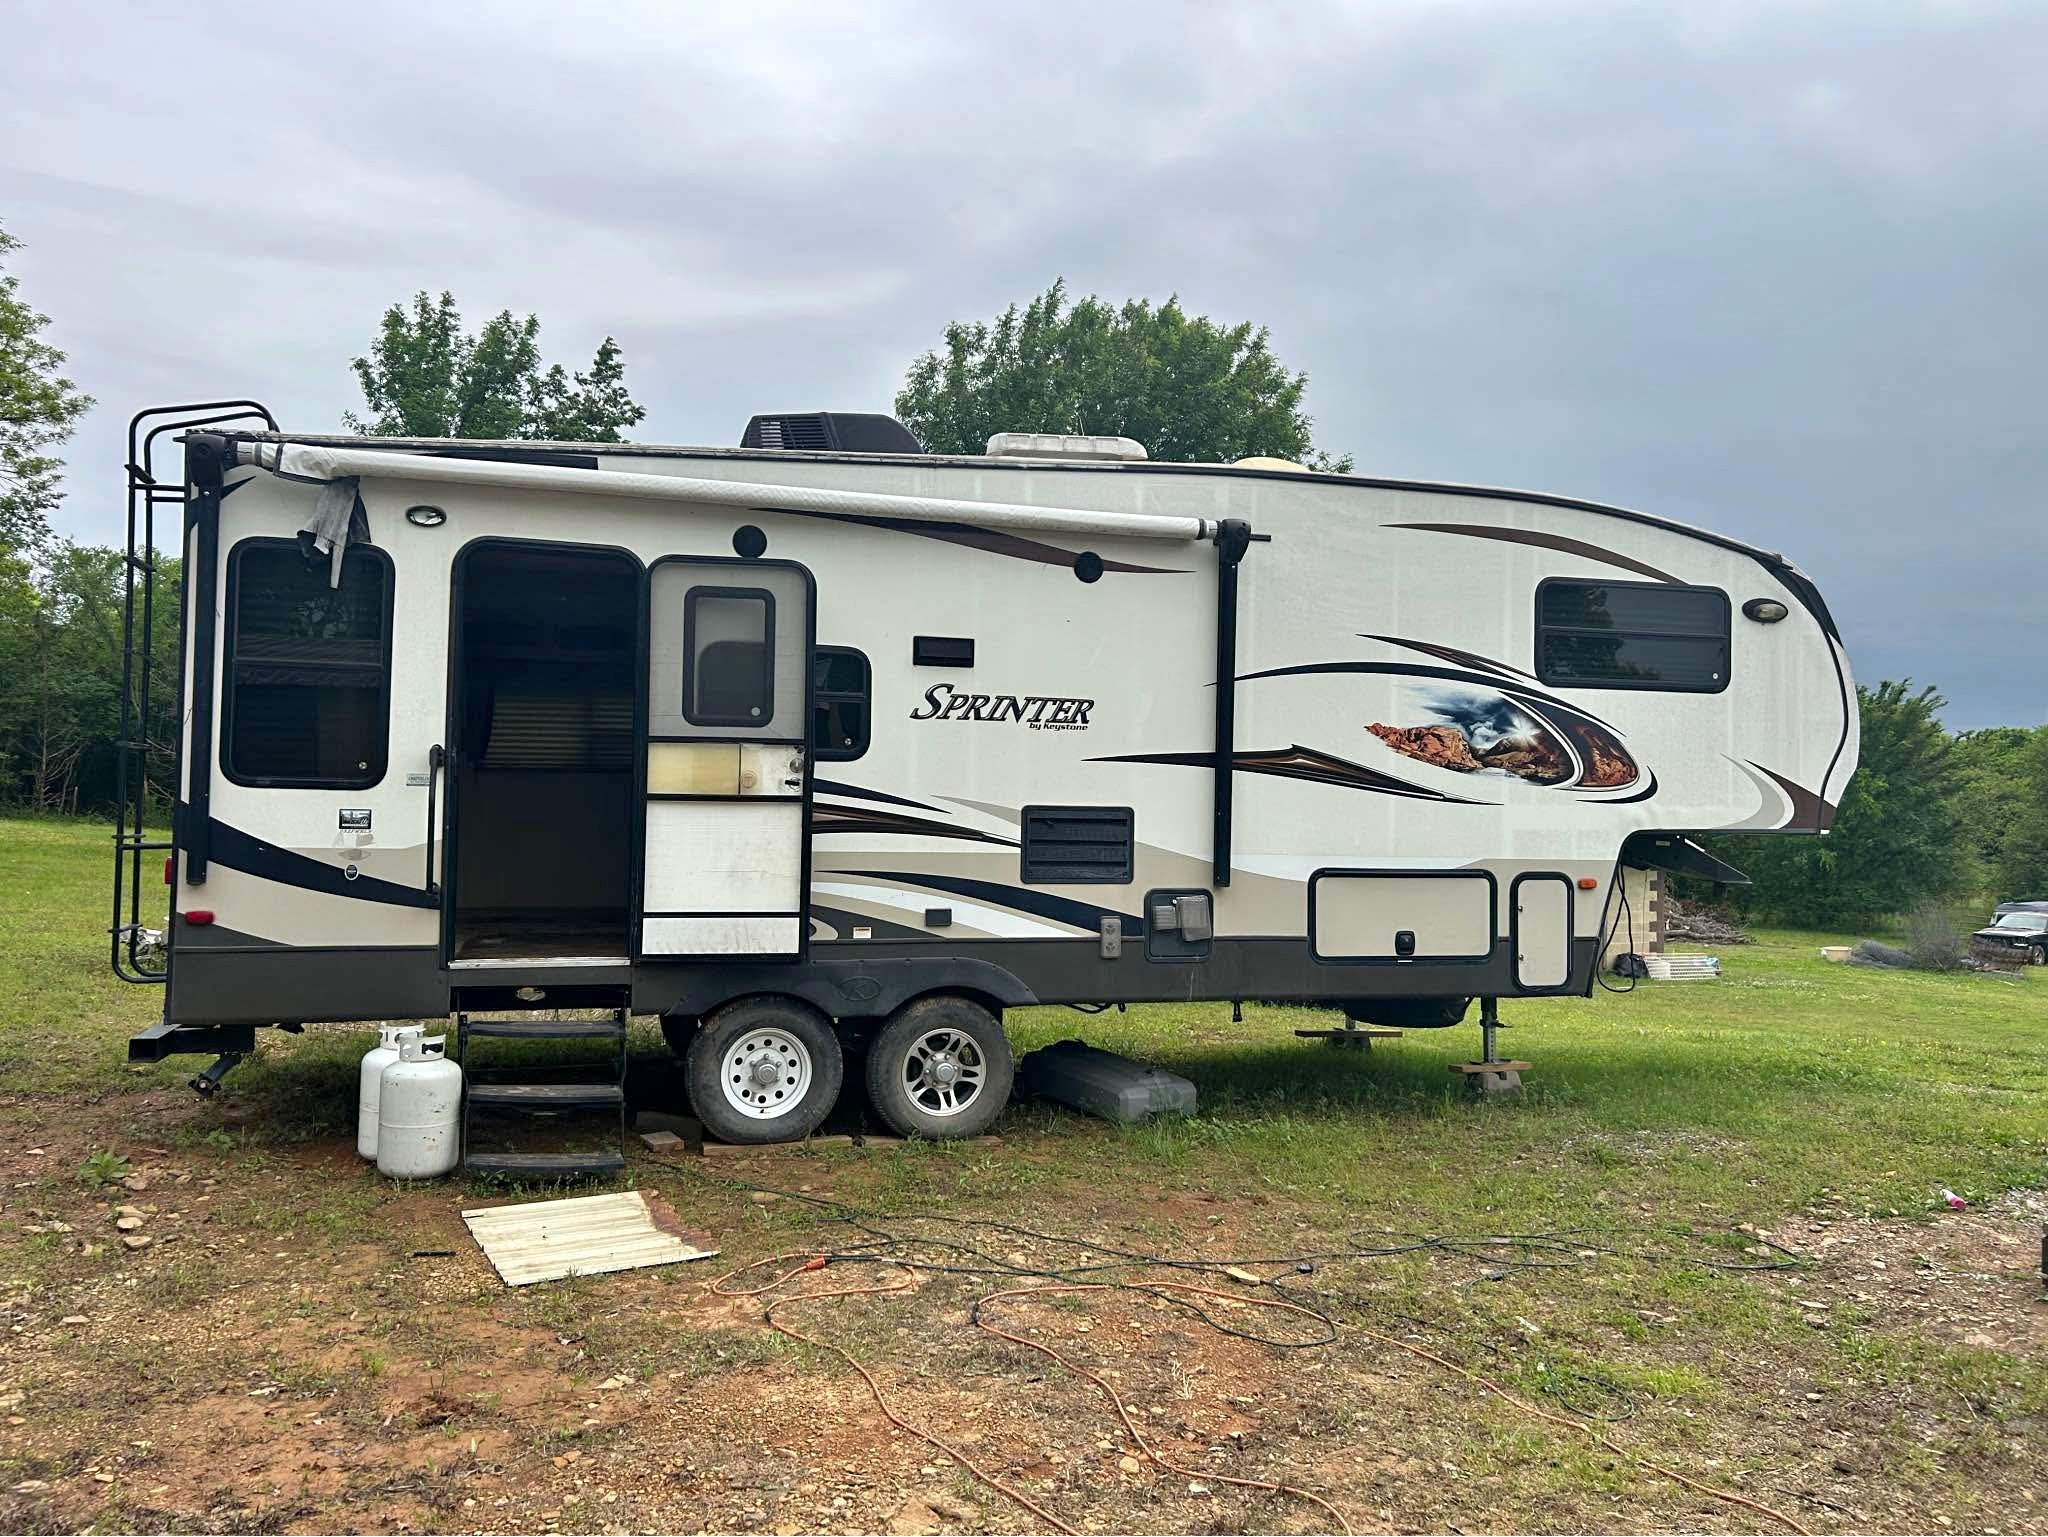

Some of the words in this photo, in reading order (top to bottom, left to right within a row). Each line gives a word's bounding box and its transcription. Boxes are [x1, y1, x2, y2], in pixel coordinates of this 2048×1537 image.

[909, 683, 1094, 724] SPRINTER
[1029, 722, 1041, 731] by
[1043, 722, 1088, 731] Keystone
